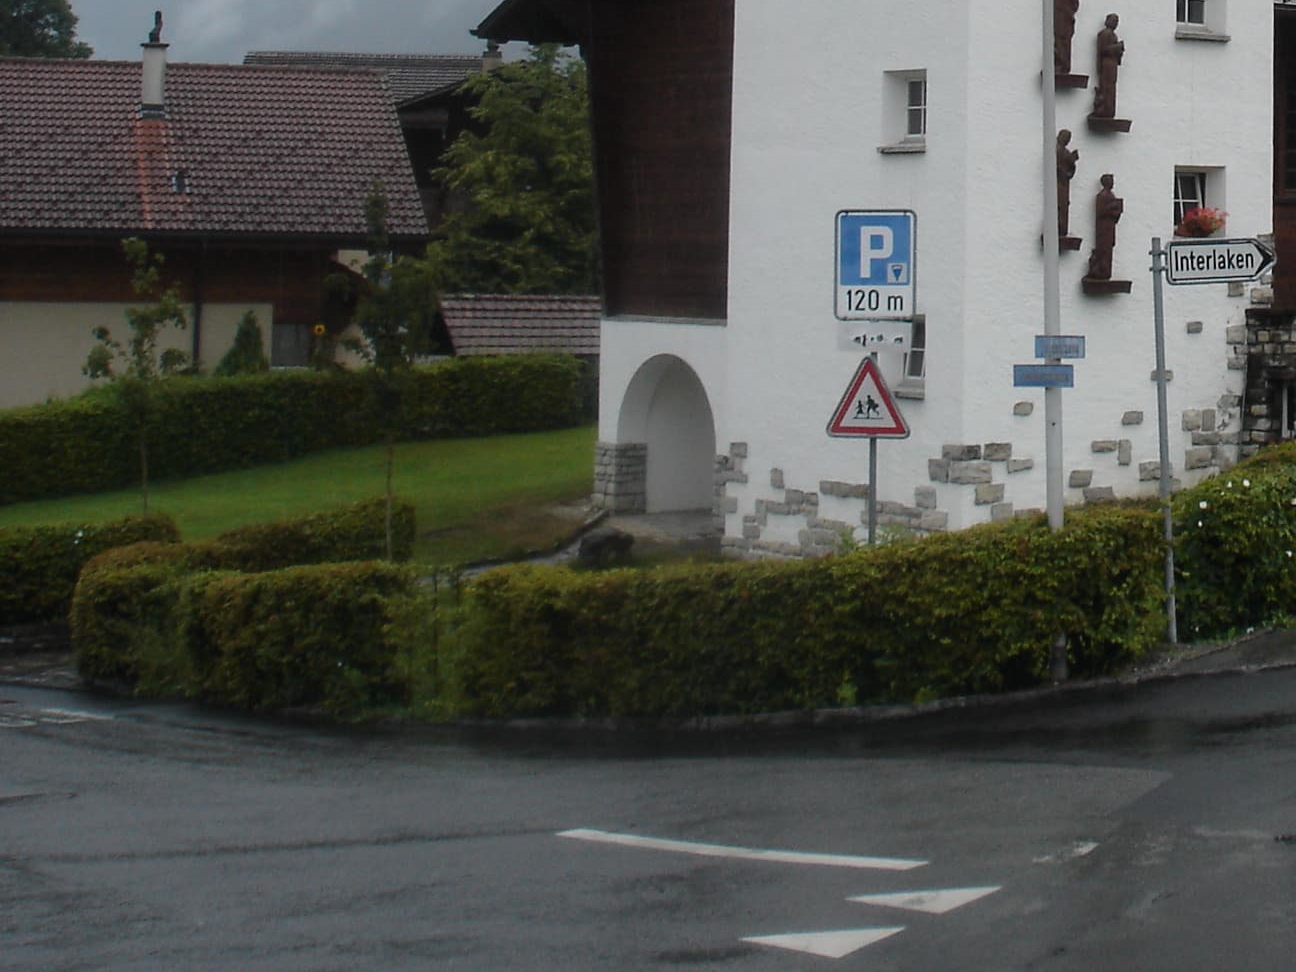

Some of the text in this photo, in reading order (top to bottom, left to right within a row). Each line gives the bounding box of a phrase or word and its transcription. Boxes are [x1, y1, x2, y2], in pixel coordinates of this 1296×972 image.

[860, 226, 893, 278] P
[1175, 248, 1254, 272] Interlaken
[847, 289, 903, 311] 120 m
